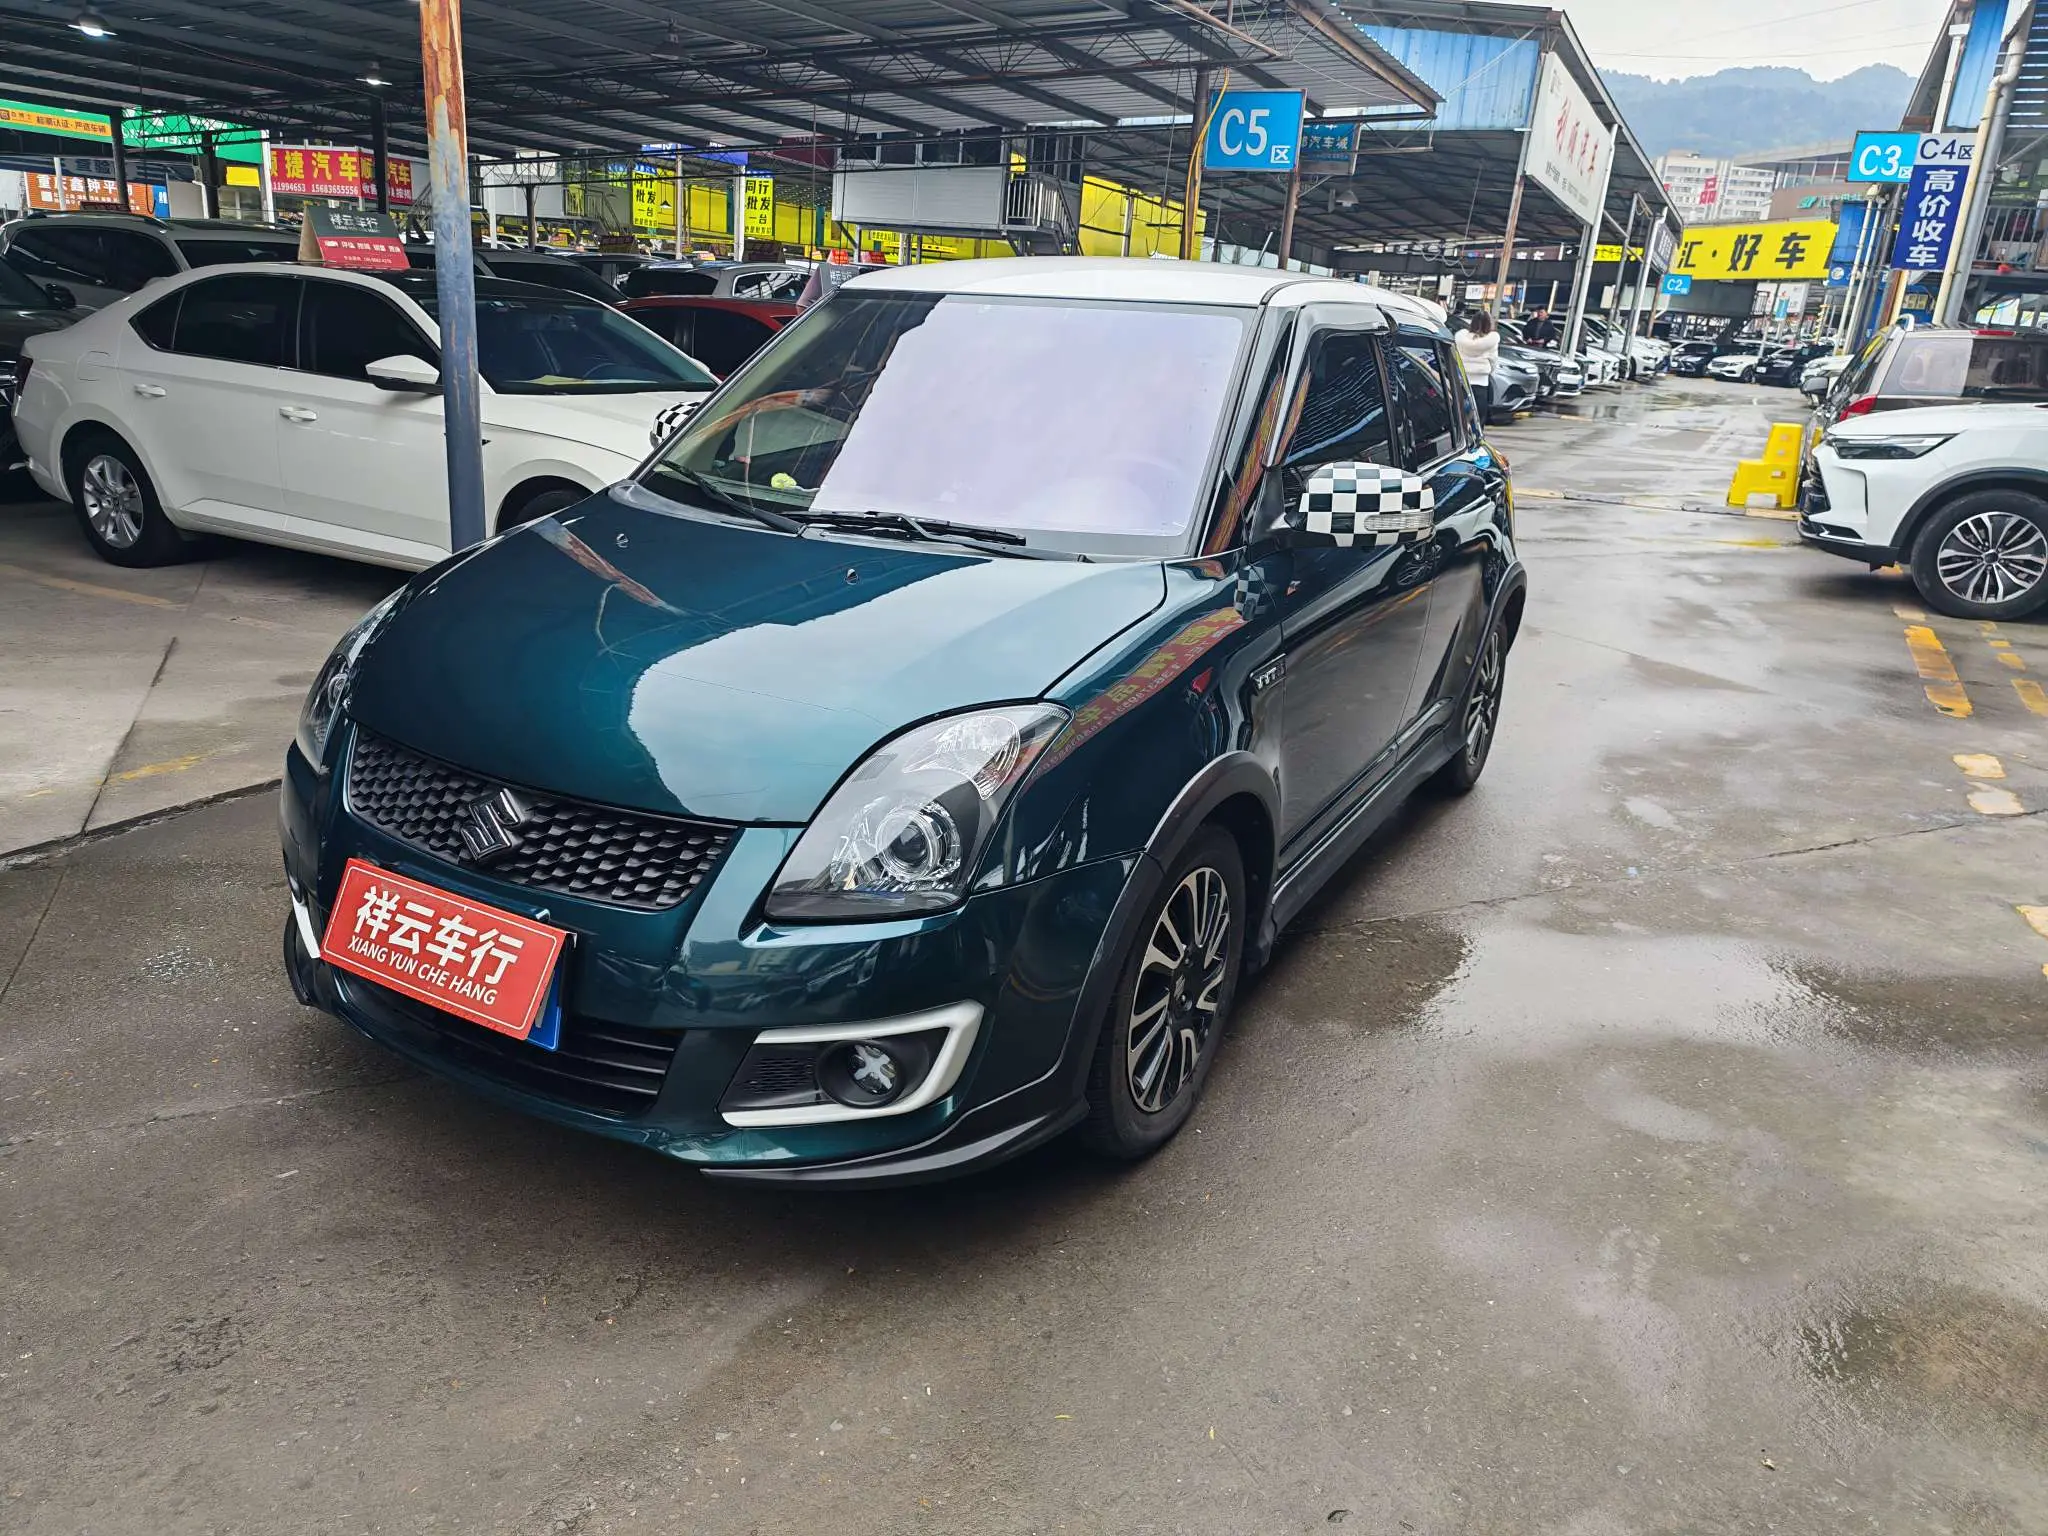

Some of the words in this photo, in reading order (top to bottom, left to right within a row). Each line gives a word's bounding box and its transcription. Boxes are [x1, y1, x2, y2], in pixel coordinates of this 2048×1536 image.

[1219, 108, 1291, 164] C5区
[1919, 138, 1975, 160] C4区
[361, 156, 411, 186] 顺汽车
[1858, 144, 1914, 179] C3区
[636, 189, 656, 204] 批发
[745, 180, 769, 194] 同行
[638, 207, 653, 217] 一台
[747, 196, 770, 210] 批发
[1905, 168, 1959, 267] 高价收车
[749, 214, 767, 224] 一台
[1677, 231, 1836, 271] 汇·好车
[354, 885, 525, 986] 祥云车行
[347, 934, 387, 963] XIANG
[387, 949, 418, 976] YUN
[417, 963, 450, 988] CHE
[448, 975, 499, 1006] HANG
